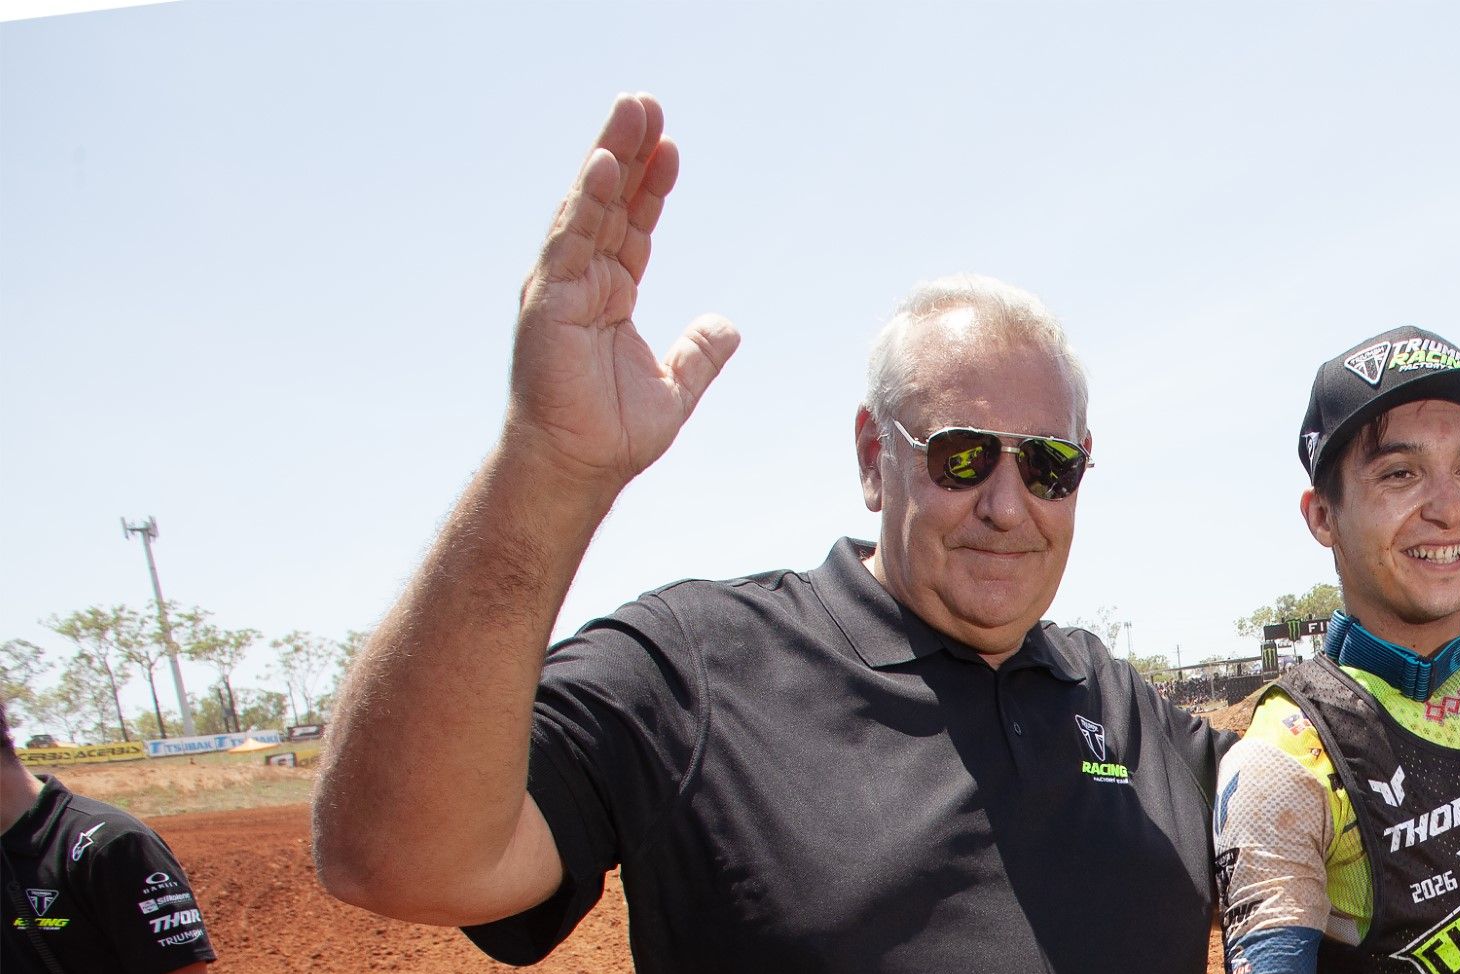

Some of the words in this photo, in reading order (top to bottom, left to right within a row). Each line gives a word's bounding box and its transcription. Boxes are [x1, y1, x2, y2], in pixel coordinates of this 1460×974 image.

[19, 752, 72, 761] CERBIS
[1082, 761, 1128, 777] RACING
[1410, 870, 1458, 904] 2026
[149, 909, 201, 933] THOR
[157, 929, 204, 947] TRIUMPH
